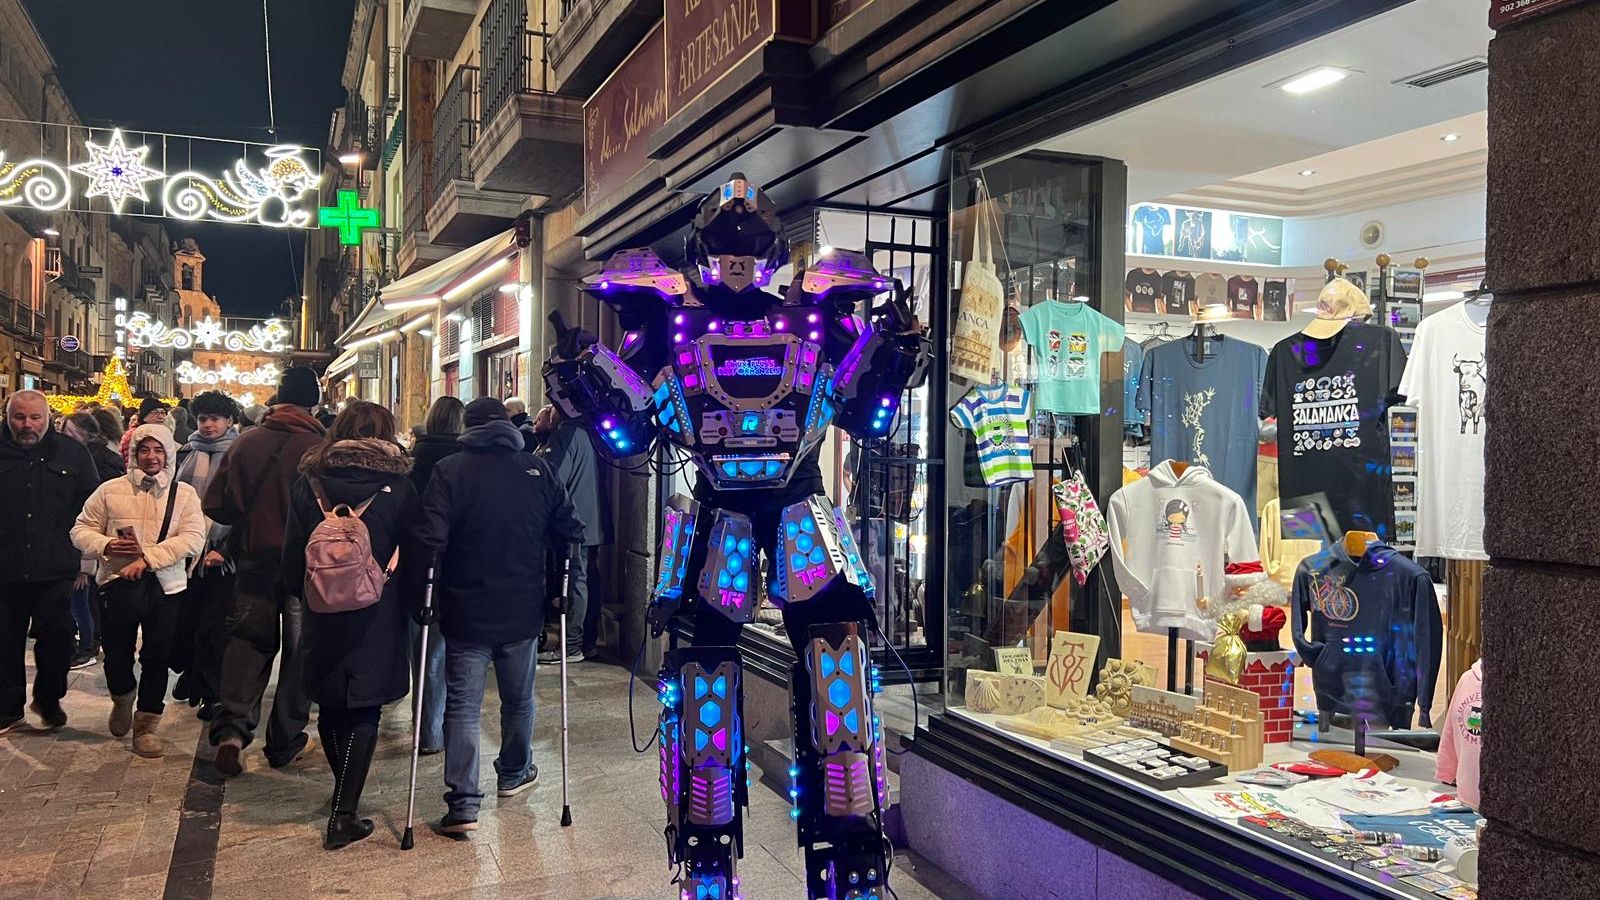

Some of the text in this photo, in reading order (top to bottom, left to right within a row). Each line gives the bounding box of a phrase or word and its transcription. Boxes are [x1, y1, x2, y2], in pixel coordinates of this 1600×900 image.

[1500, 2, 1514, 14] 902
[678, 0, 760, 97] ARTESANIA
[1292, 403, 1360, 426] SALAMANCA
